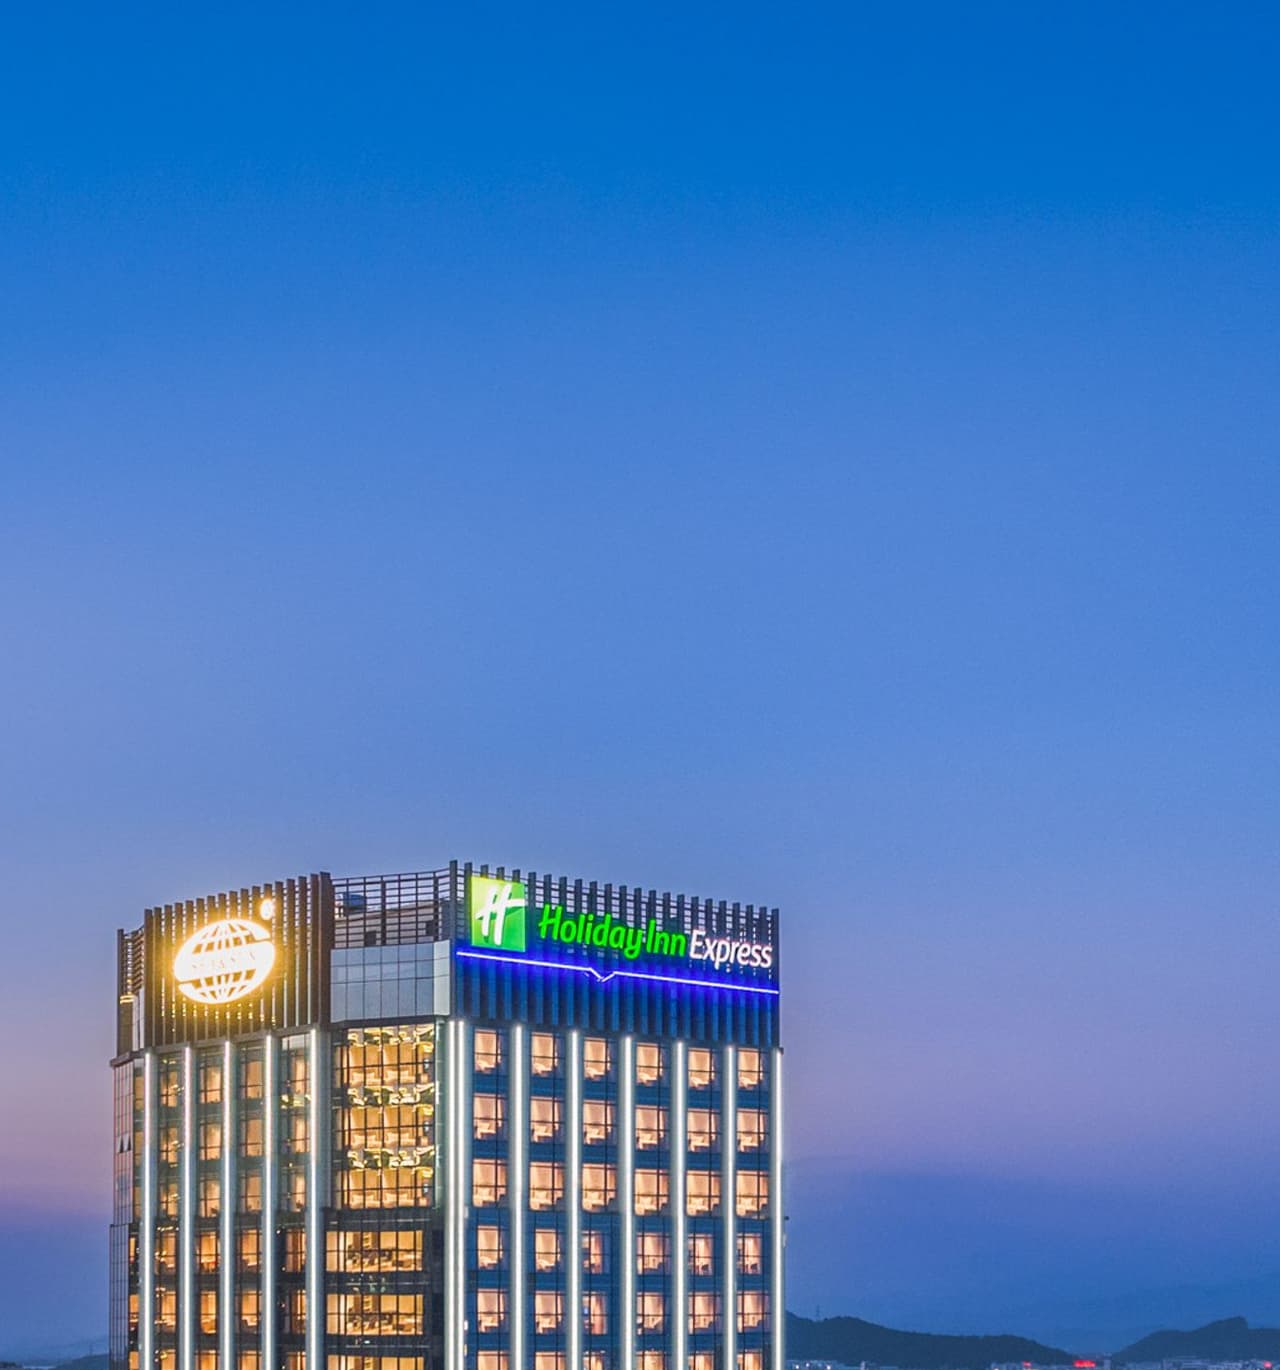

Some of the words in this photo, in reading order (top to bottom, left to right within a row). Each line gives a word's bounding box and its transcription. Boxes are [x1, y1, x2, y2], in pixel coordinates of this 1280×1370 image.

[538, 903, 644, 960] Holiday
[645, 918, 687, 957] Inn
[689, 928, 773, 971] Express
